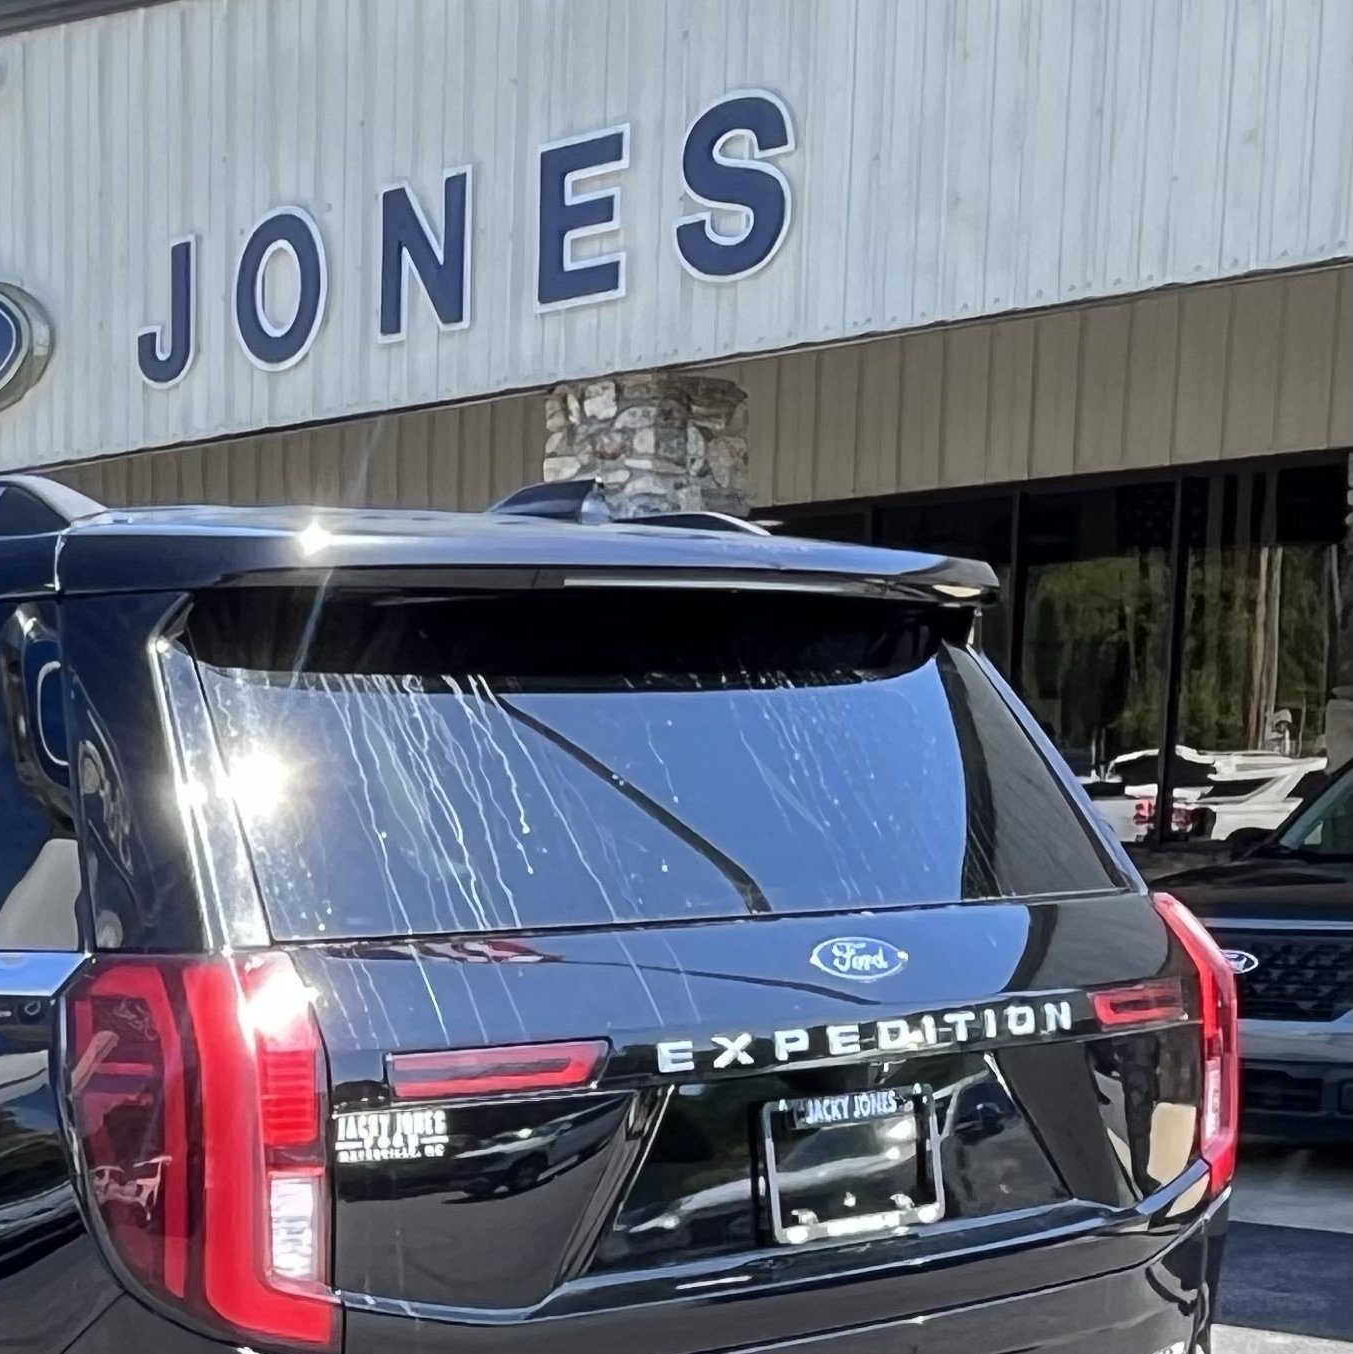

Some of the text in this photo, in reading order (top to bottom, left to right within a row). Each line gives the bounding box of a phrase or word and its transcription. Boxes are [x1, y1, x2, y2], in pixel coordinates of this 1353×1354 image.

[137, 88, 796, 390] JONES
[831, 941, 888, 972] Ford
[656, 1001, 1072, 1073] EXPEDITION
[806, 1089, 897, 1124] JACKY JONES
